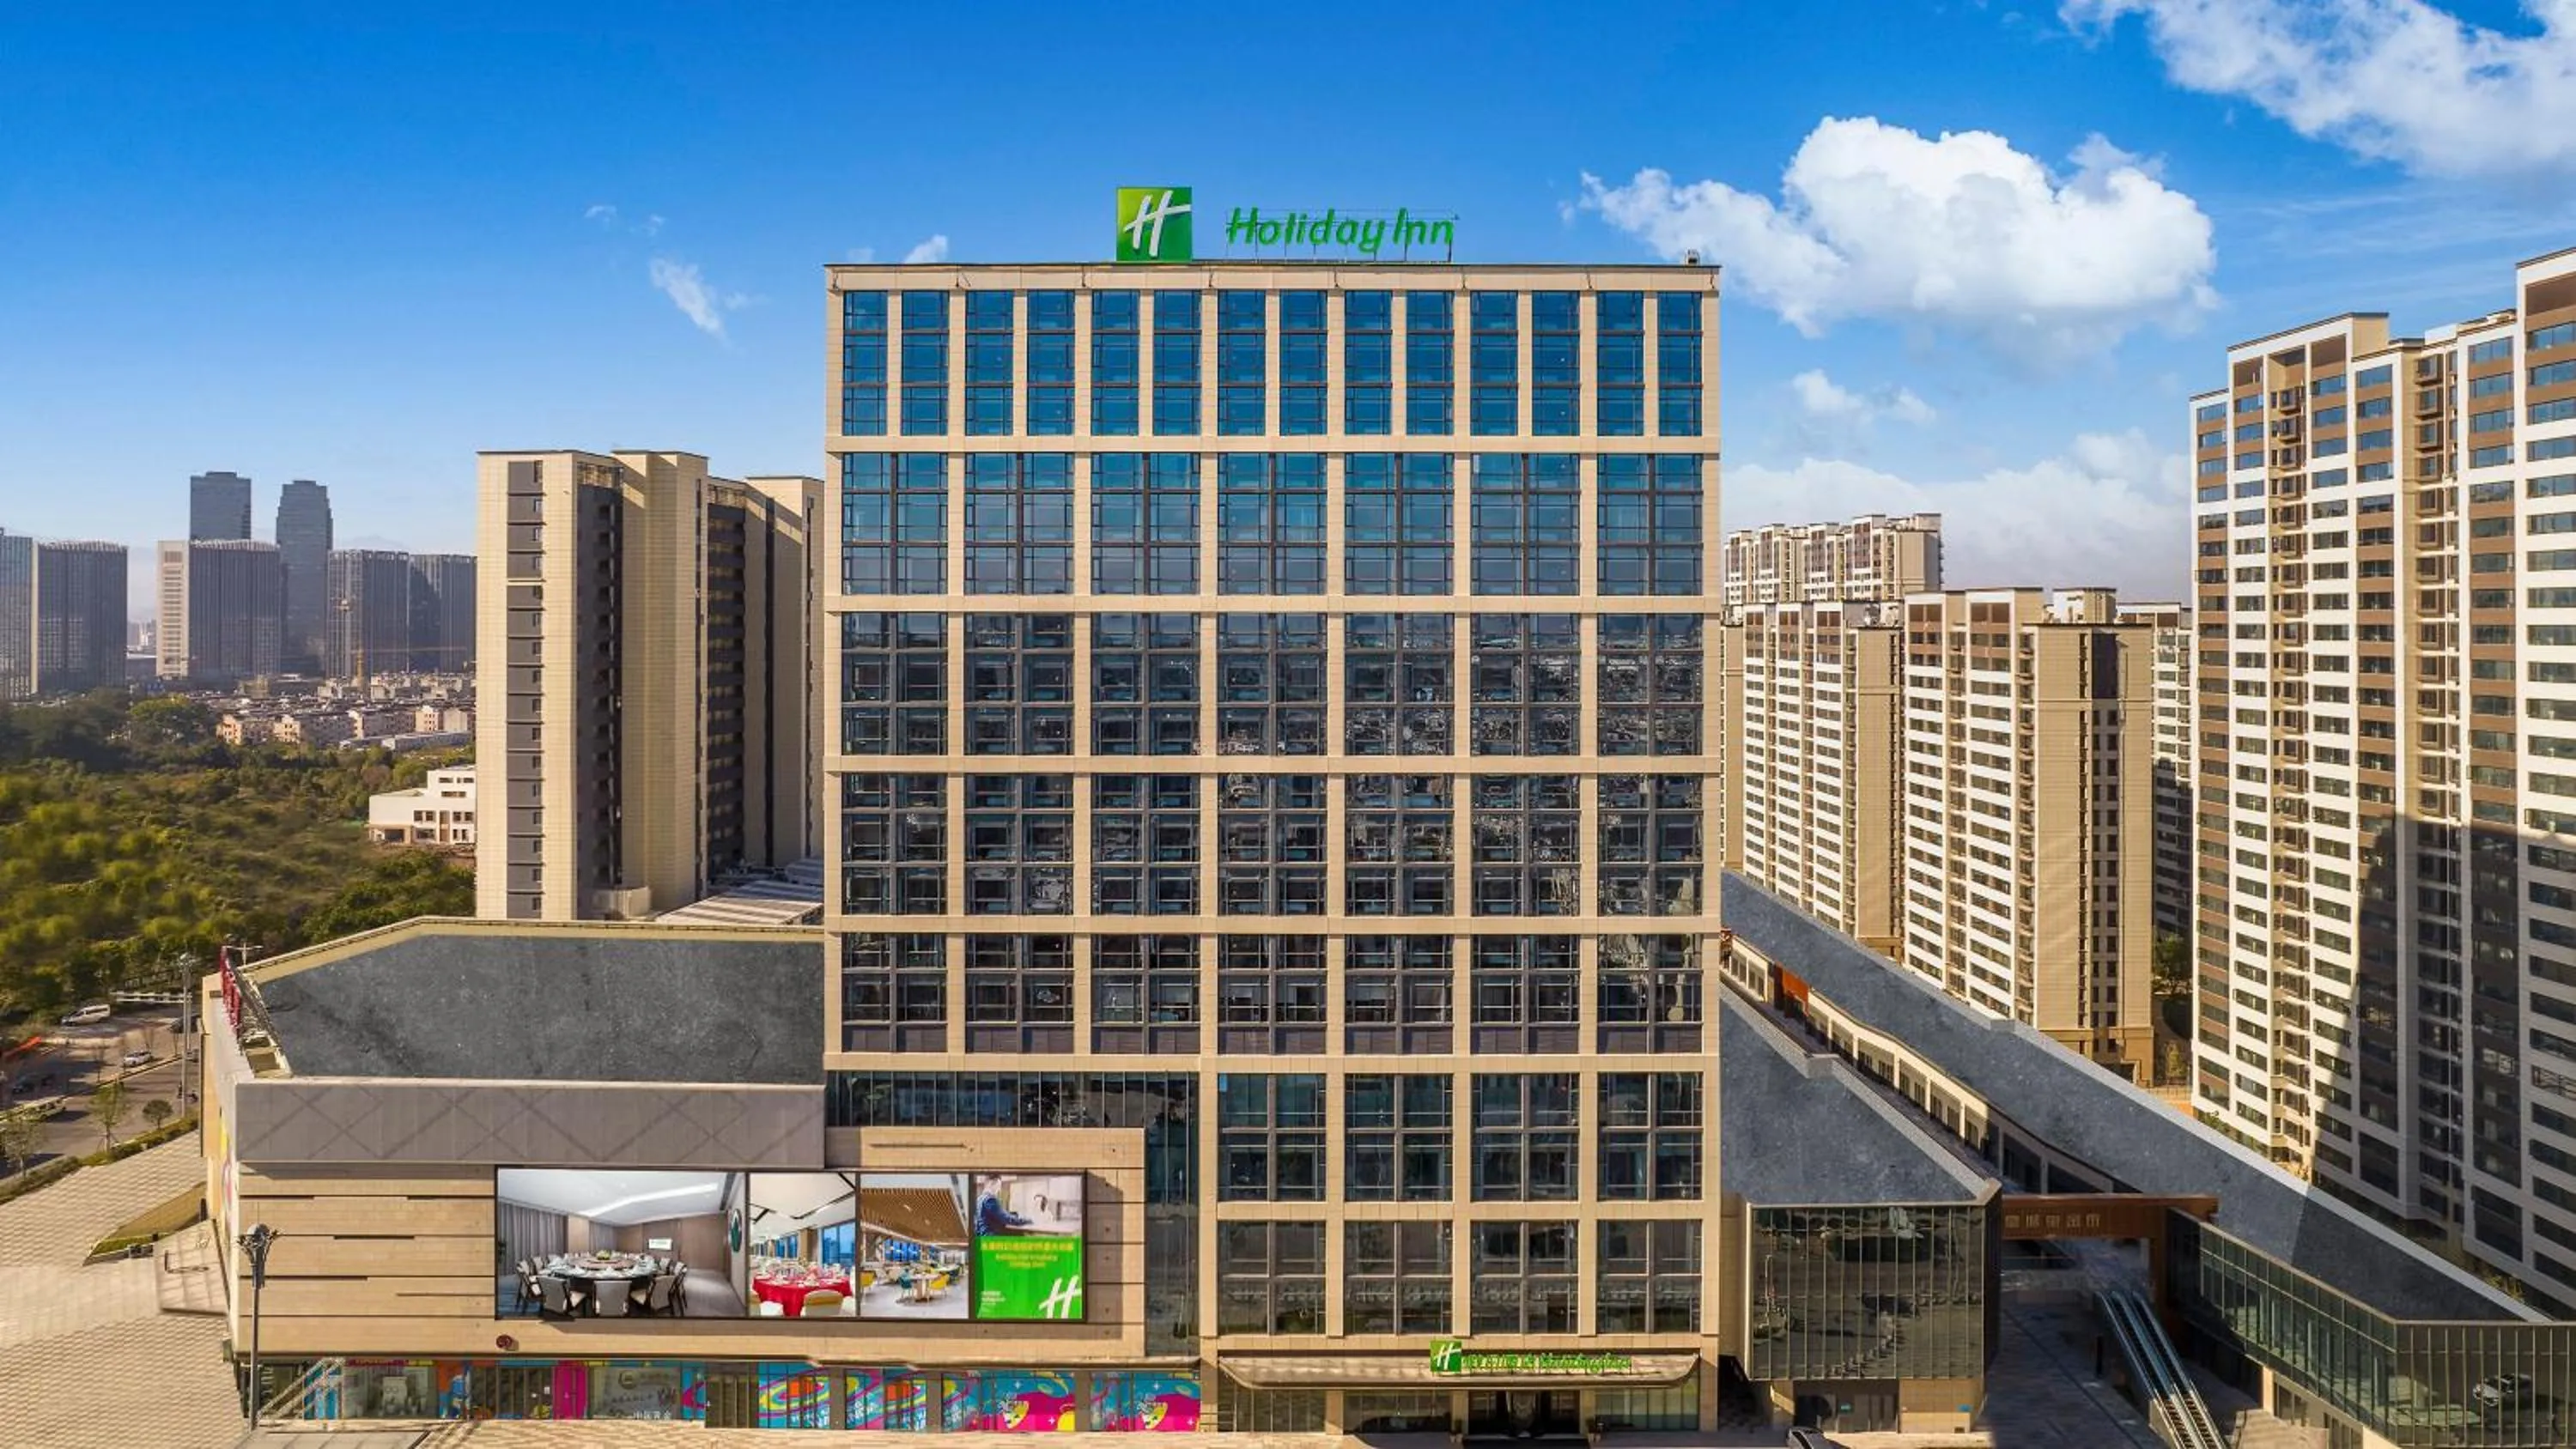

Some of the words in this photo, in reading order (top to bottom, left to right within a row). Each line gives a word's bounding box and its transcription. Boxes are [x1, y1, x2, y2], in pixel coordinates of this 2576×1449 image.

[1122, 190, 1192, 257] H
[1227, 207, 1385, 252] Holiday
[1393, 207, 1453, 245] Inn
